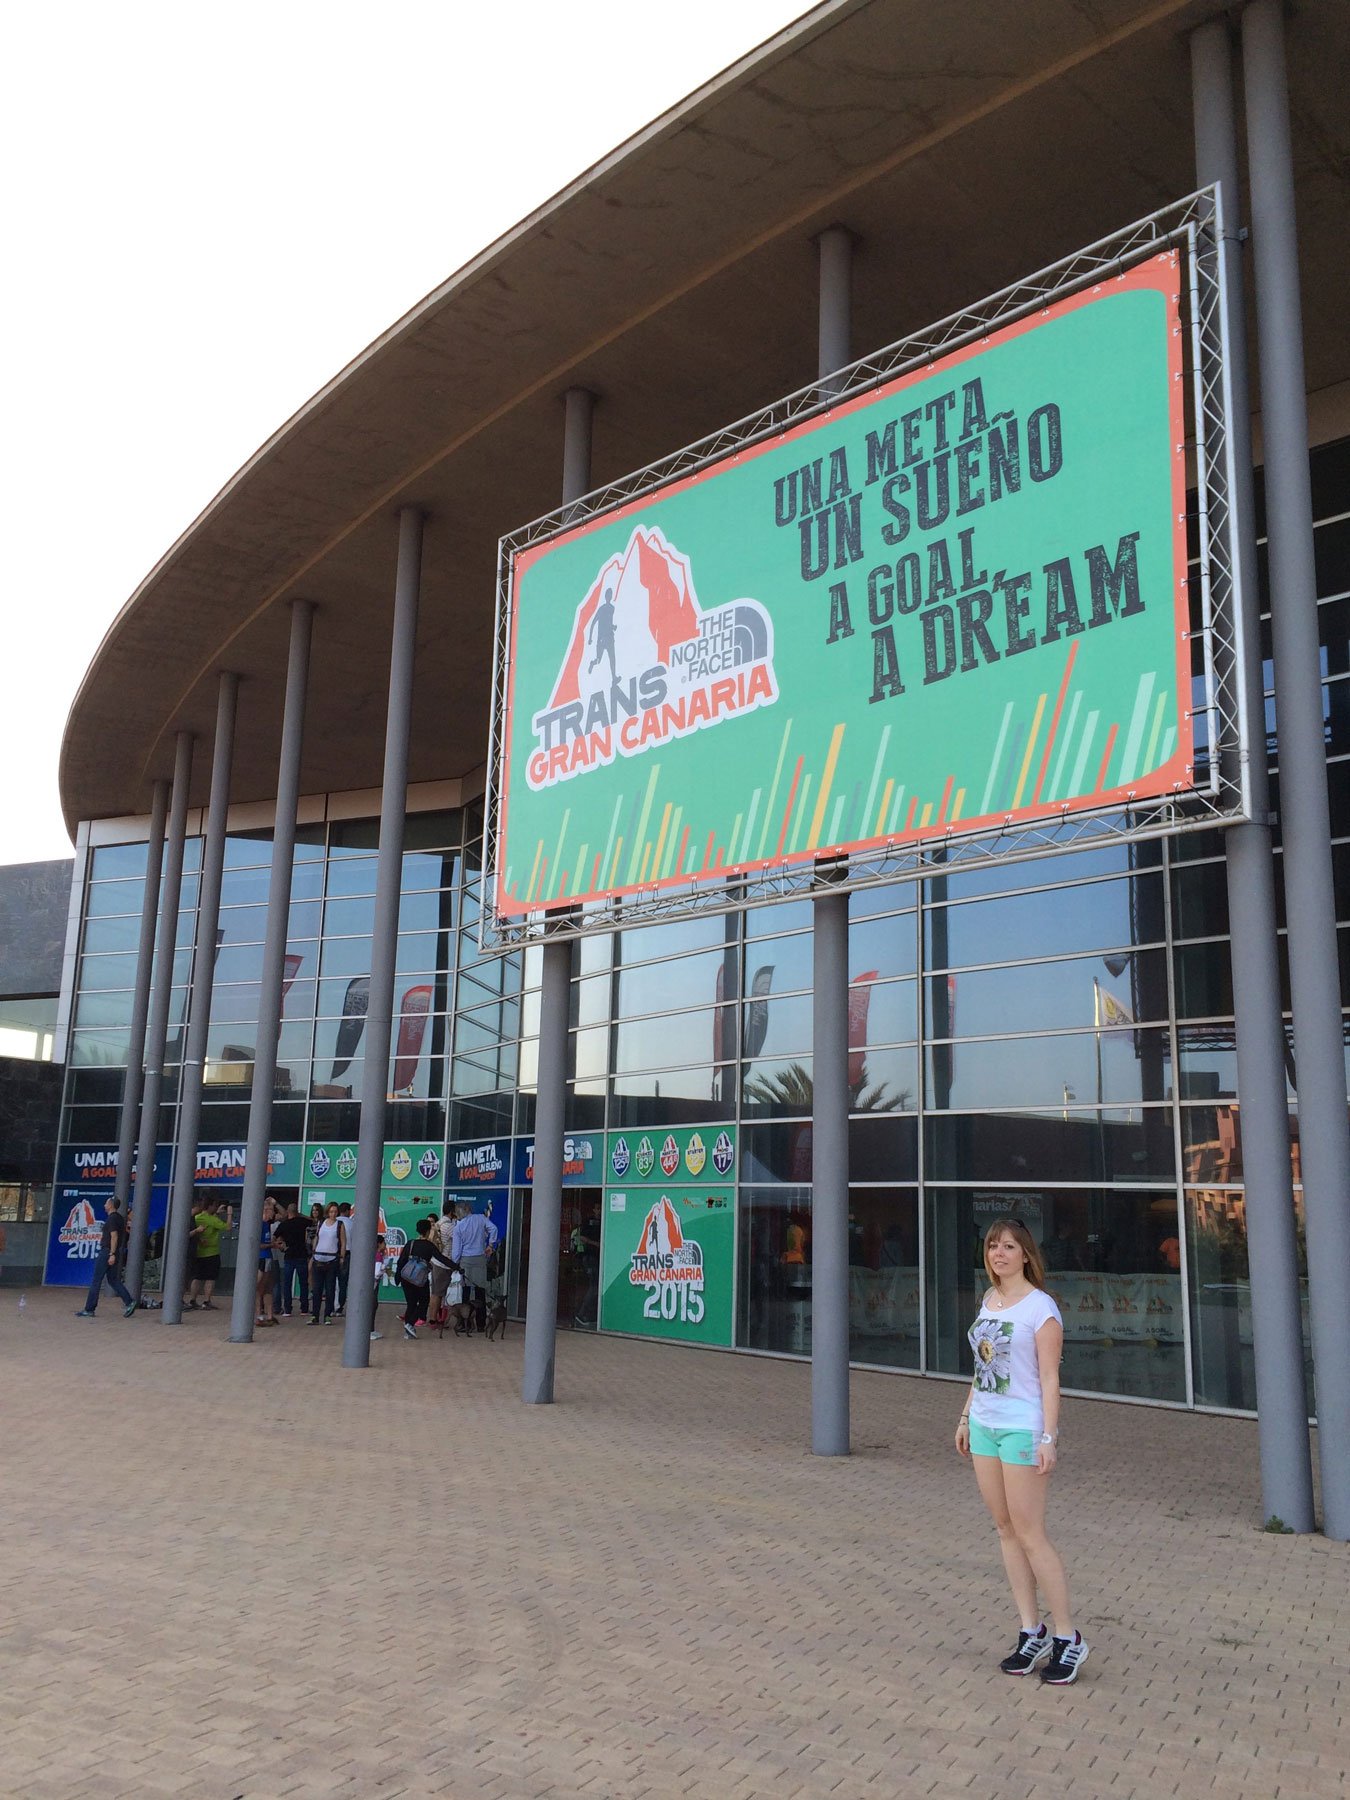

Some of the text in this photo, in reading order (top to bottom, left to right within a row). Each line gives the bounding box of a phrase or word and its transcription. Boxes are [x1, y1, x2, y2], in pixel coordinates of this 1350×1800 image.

[774, 446, 852, 527] UNA
[798, 403, 1063, 582] UN SUEÑO
[826, 581, 855, 645] A
[869, 531, 1145, 704] A DREAM
[699, 609, 734, 635] THE
[672, 629, 734, 667] NORTH
[688, 650, 733, 682] FACE
[536, 665, 667, 752] TRANS
[529, 663, 773, 784] GRAN CANARIA
[75, 1152, 104, 1167] UNA
[197, 1149, 247, 1169] TRAN
[456, 1149, 473, 1168] UNA
[614, 1158, 626, 1170] 125
[638, 1158, 649, 1169] 83
[663, 1156, 674, 1169] 44
[716, 1153, 727, 1169] 17
[82, 1168, 89, 1178] A
[423, 1165, 433, 1176] 17
[62, 1227, 89, 1235] TRANS
[674, 1248, 693, 1257] NORTH
[683, 1242, 693, 1250] THE
[632, 1253, 674, 1270] TRANS
[679, 1256, 692, 1265] FACE
[630, 1267, 703, 1282] GRAN CANARIA
[643, 1281, 705, 1323] 2015
